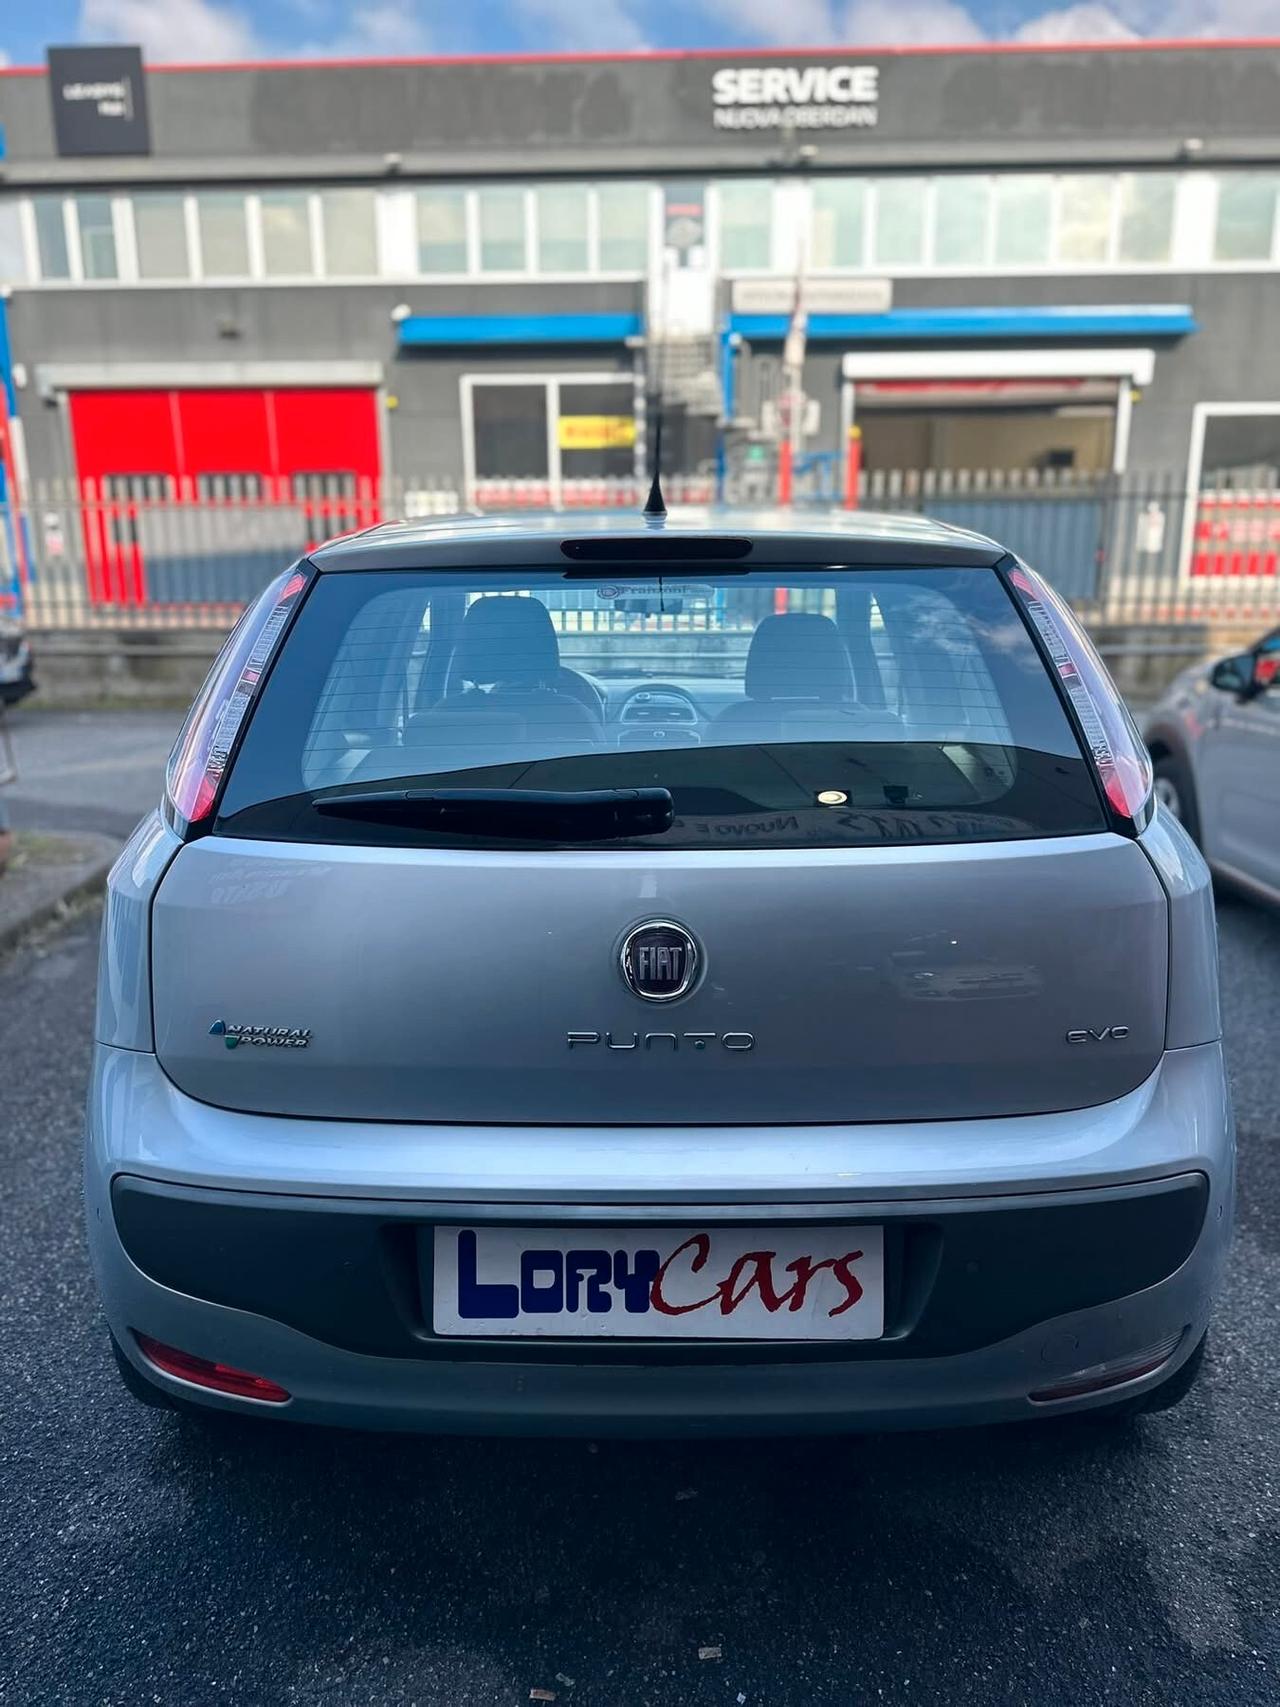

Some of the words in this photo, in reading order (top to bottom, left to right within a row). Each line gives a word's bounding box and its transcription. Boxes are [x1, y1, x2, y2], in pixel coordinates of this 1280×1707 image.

[712, 65, 879, 105] SERVICE
[639, 946, 682, 980] FIAT
[227, 1024, 312, 1039] NATURAL
[567, 1031, 756, 1050] PUNTO
[1066, 1025, 1129, 1044] EVO
[239, 1036, 310, 1048] POWER
